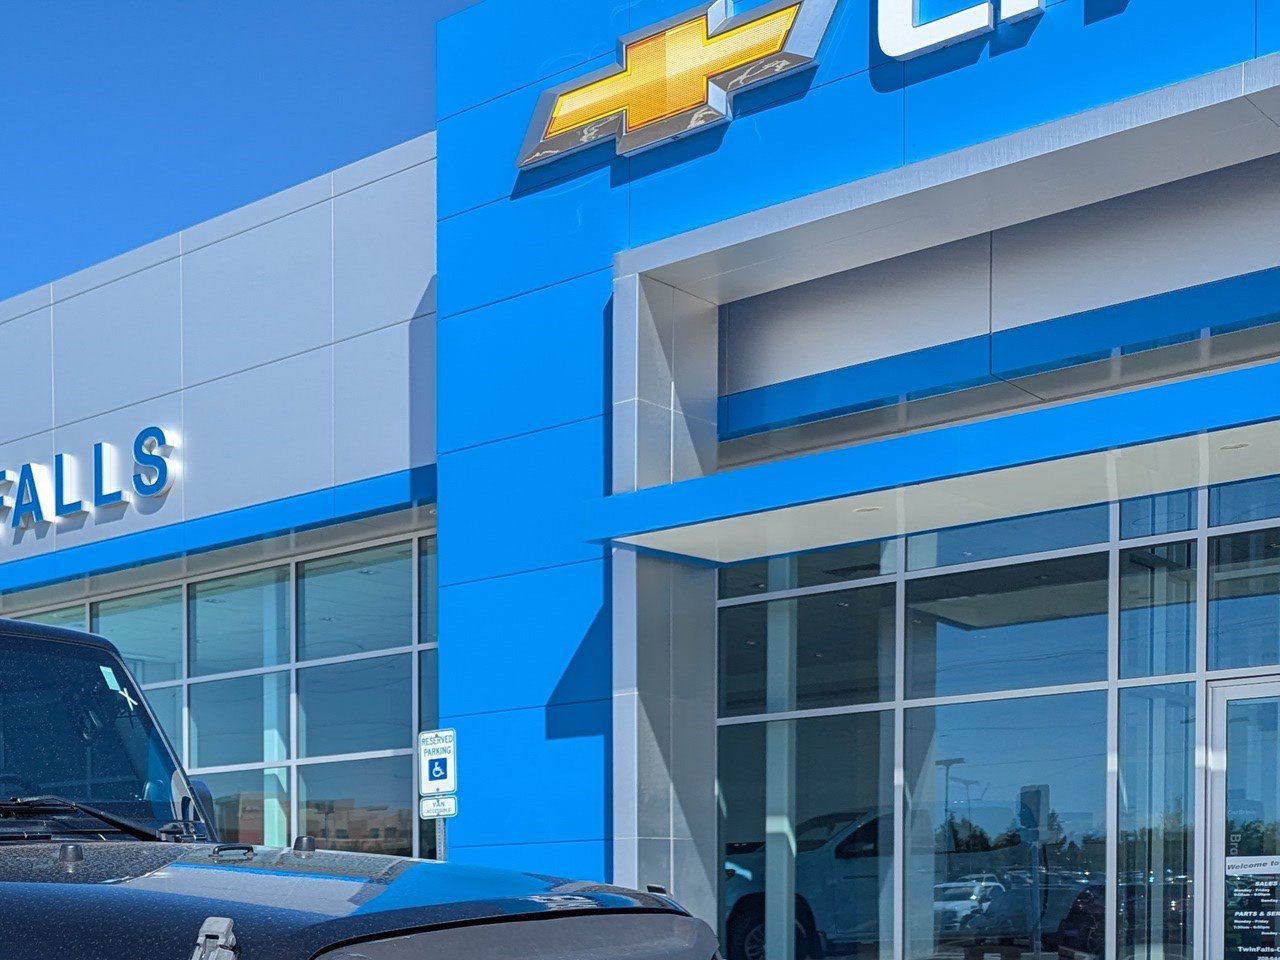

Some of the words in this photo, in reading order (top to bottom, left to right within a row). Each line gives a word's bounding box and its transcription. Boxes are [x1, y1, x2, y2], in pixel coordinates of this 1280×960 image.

[421, 734, 453, 746] RESERVED
[423, 746, 452, 757] PARKING
[1227, 860, 1268, 871] Welcome
[1270, 859, 1280, 867] to
